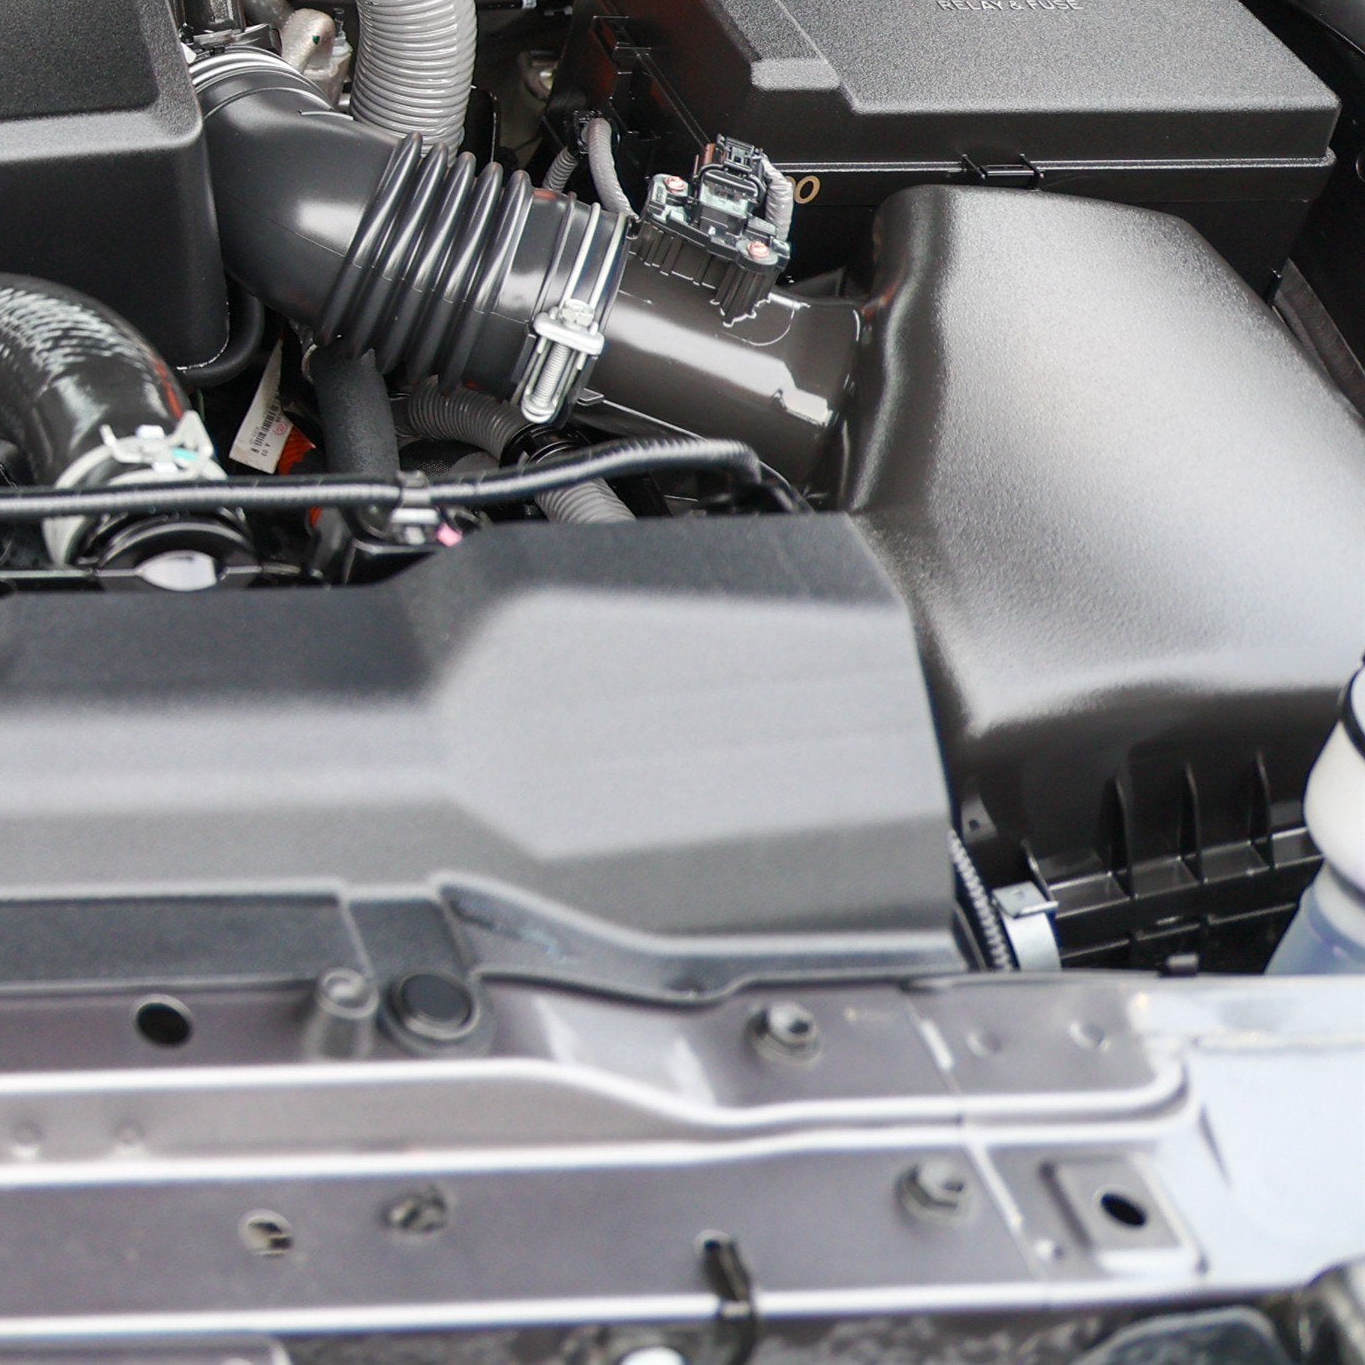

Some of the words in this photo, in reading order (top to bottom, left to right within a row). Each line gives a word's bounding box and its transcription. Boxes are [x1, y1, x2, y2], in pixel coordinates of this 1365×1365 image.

[936, 0, 1004, 11] RELAY
[1008, 0, 1025, 11] &
[1028, 0, 1084, 11] FUSE
